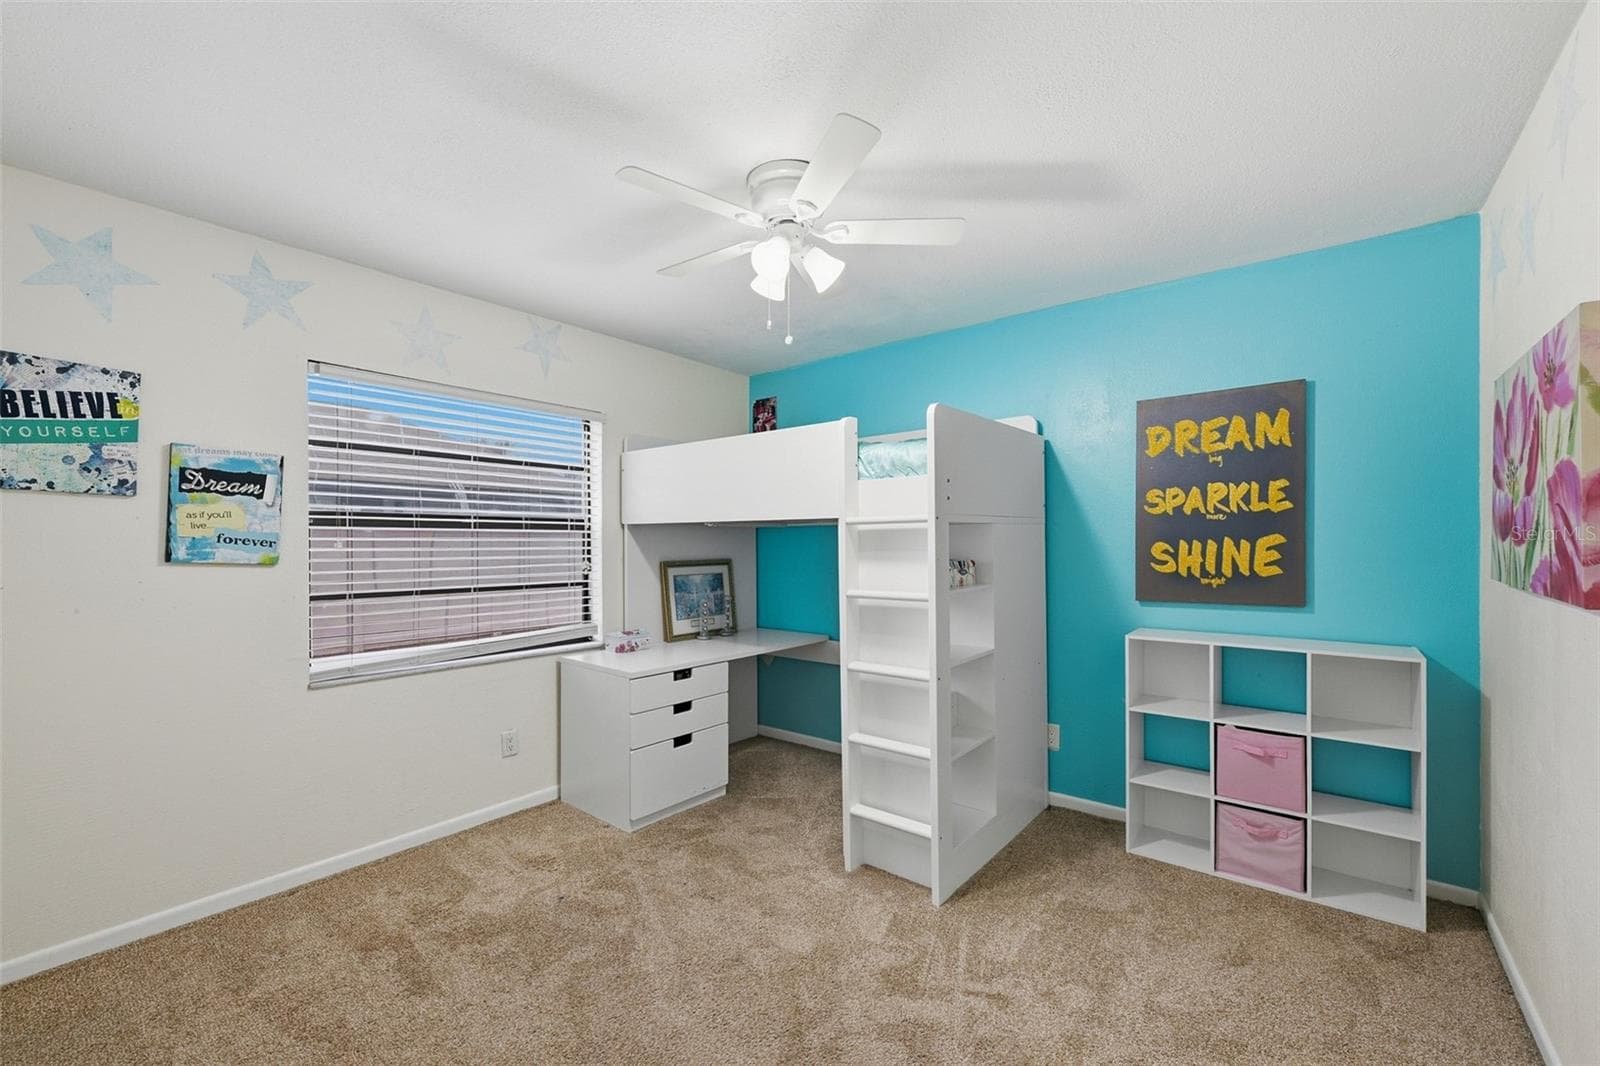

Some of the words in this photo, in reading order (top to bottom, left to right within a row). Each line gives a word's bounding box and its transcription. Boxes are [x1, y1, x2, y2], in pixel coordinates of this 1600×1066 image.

[0, 389, 123, 418] BELIEVE
[0, 425, 130, 437] YOURSELF
[1145, 408, 1292, 457] DREAM
[194, 446, 231, 456] dreams
[181, 469, 264, 495] Dream
[1144, 479, 1293, 515] SPARKLE
[185, 511, 198, 519] as
[199, 510, 206, 519] if
[207, 510, 233, 521] you'll
[216, 533, 278, 549] forever
[1150, 534, 1287, 578] SHINE
